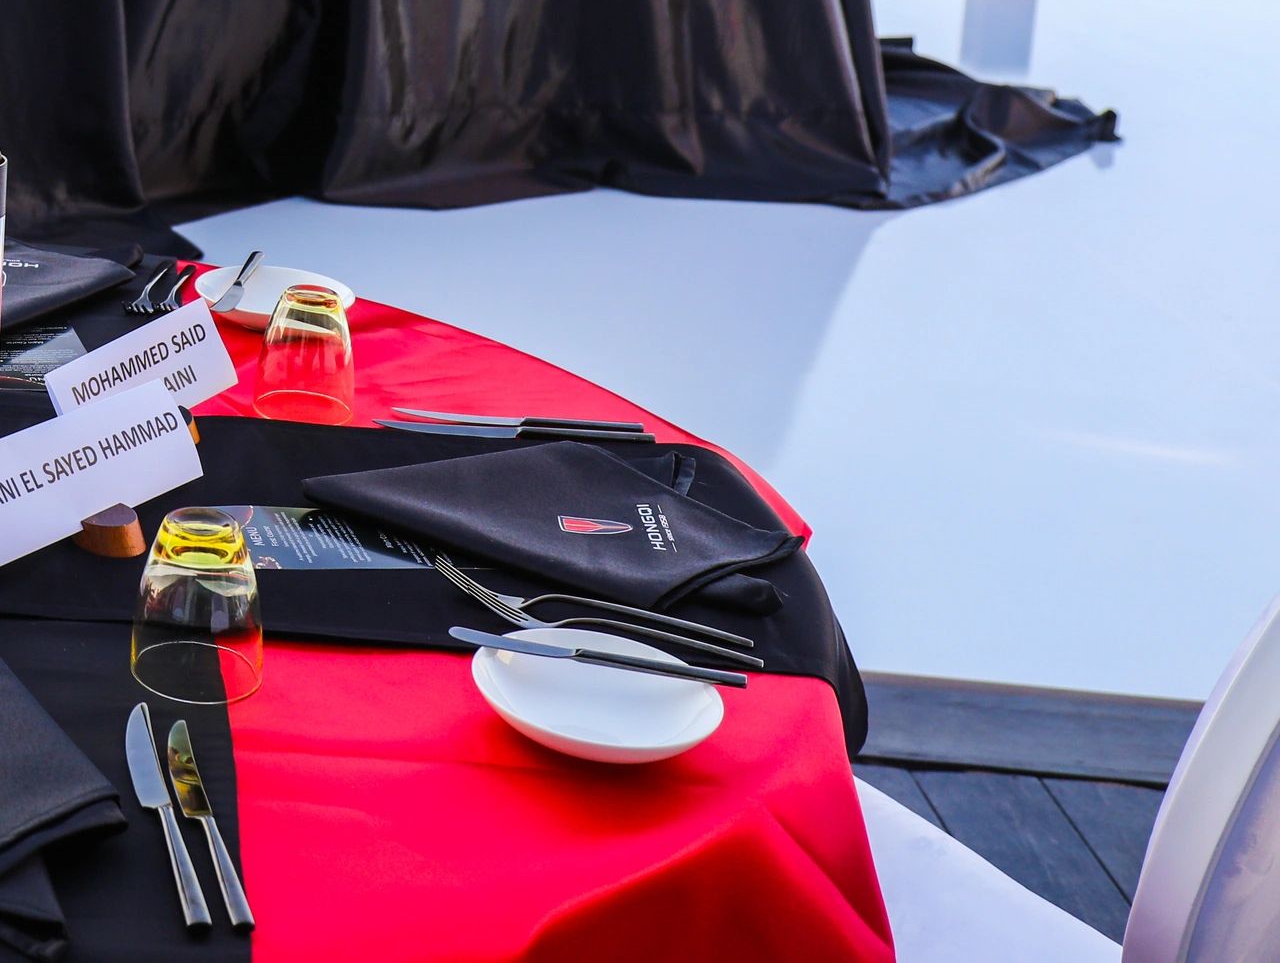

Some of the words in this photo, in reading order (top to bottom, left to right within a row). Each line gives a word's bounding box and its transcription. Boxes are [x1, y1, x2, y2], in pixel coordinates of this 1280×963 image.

[71, 341, 169, 406] MOHAMMED
[171, 323, 206, 354] SAID
[19, 469, 44, 493] EL
[42, 445, 98, 484] SAYED
[98, 411, 179, 460] HAMMAD
[245, 526, 265, 547] MENU
[636, 504, 667, 551] HONGQI
